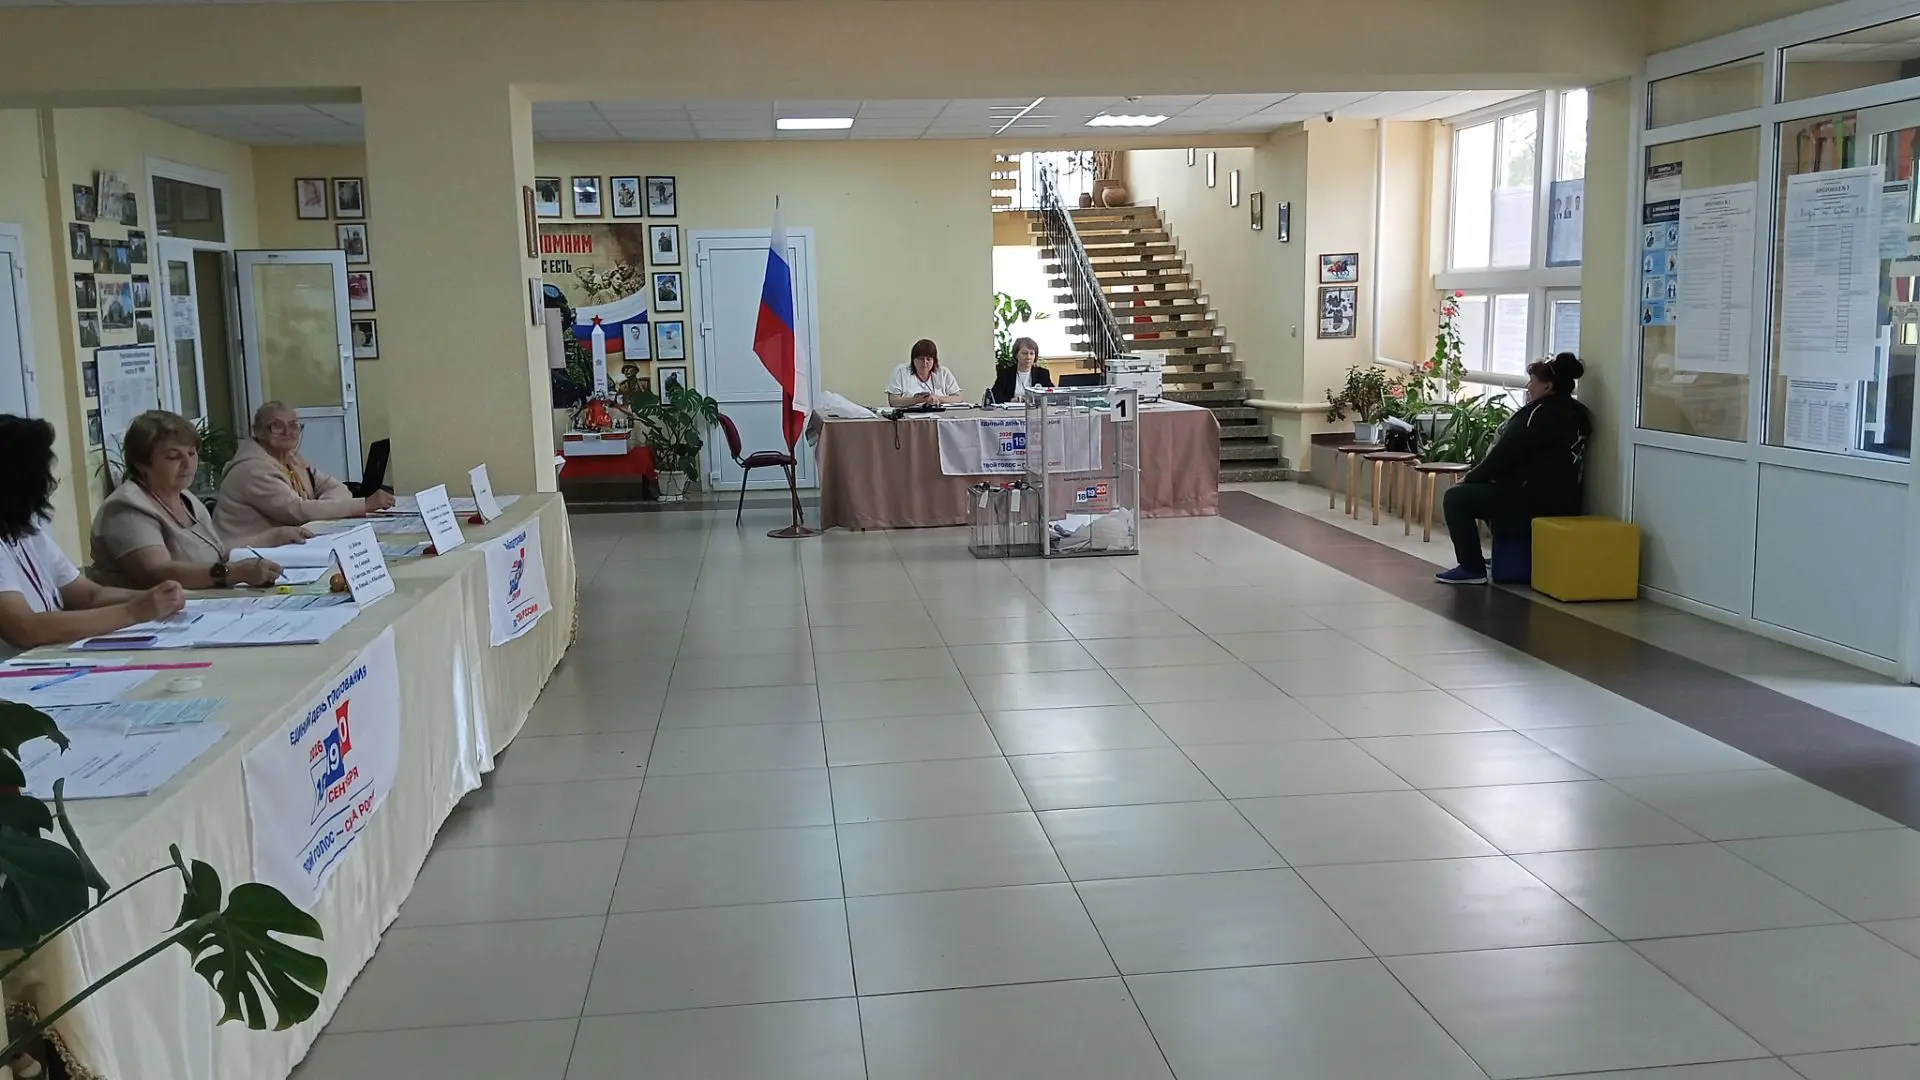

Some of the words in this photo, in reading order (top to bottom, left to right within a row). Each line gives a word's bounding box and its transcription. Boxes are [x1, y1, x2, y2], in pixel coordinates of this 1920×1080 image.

[541, 259, 547, 273] С
[550, 259, 572, 273] ЕСТЬ
[1115, 399, 1126, 417] 1
[1001, 443, 1012, 452] 18
[1014, 436, 1026, 446] 19
[1077, 493, 1086, 501] 18
[1096, 485, 1106, 494] 20
[338, 715, 348, 743] 0
